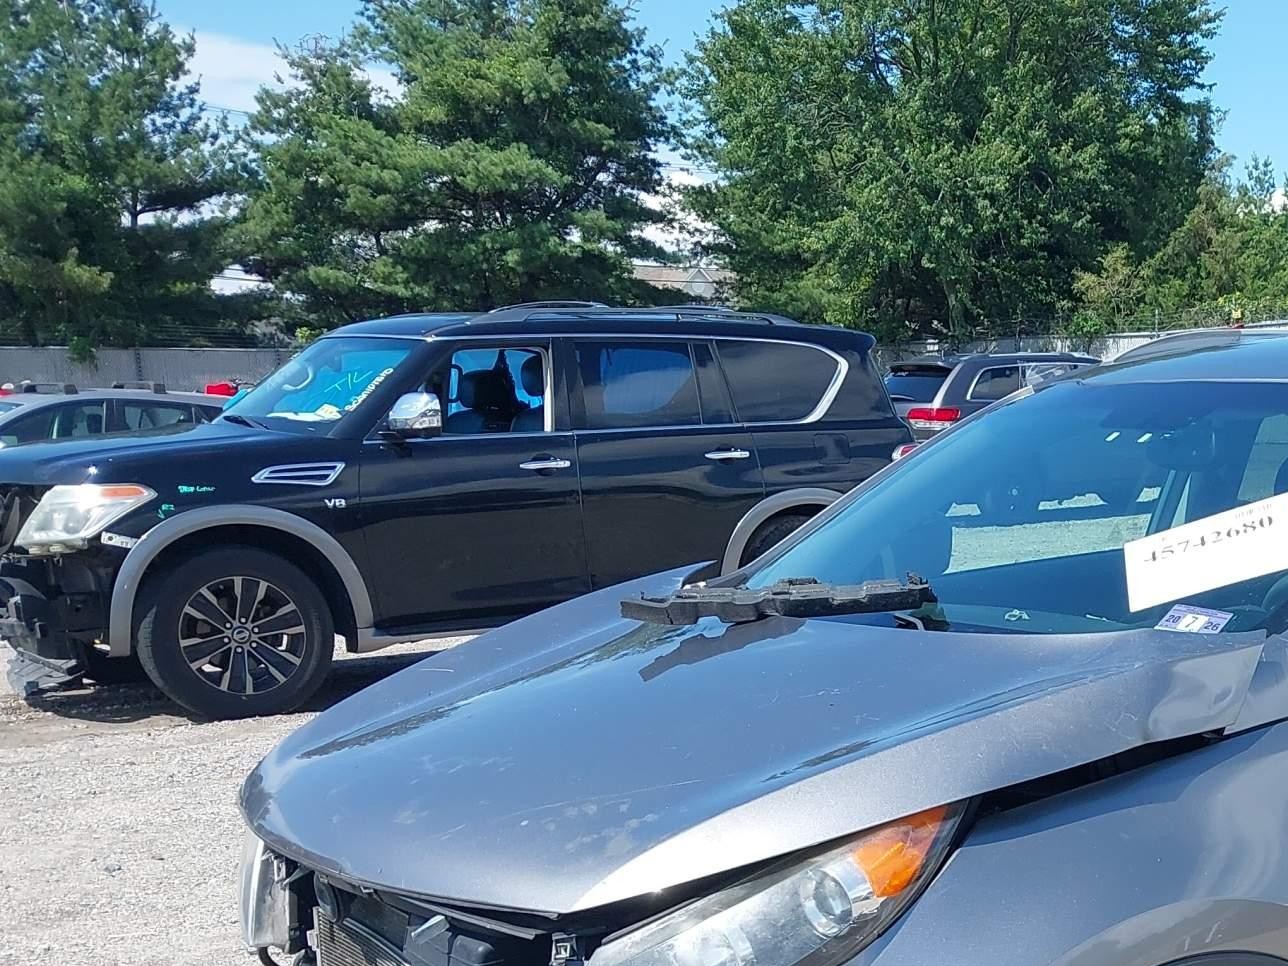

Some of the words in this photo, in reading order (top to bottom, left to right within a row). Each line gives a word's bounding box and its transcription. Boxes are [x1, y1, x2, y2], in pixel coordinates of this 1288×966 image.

[323, 498, 347, 509] V8
[1143, 515, 1274, 562] 45742680
[1165, 614, 1182, 624] 20
[1184, 615, 1199, 628] 7
[1203, 621, 1221, 632] 26
